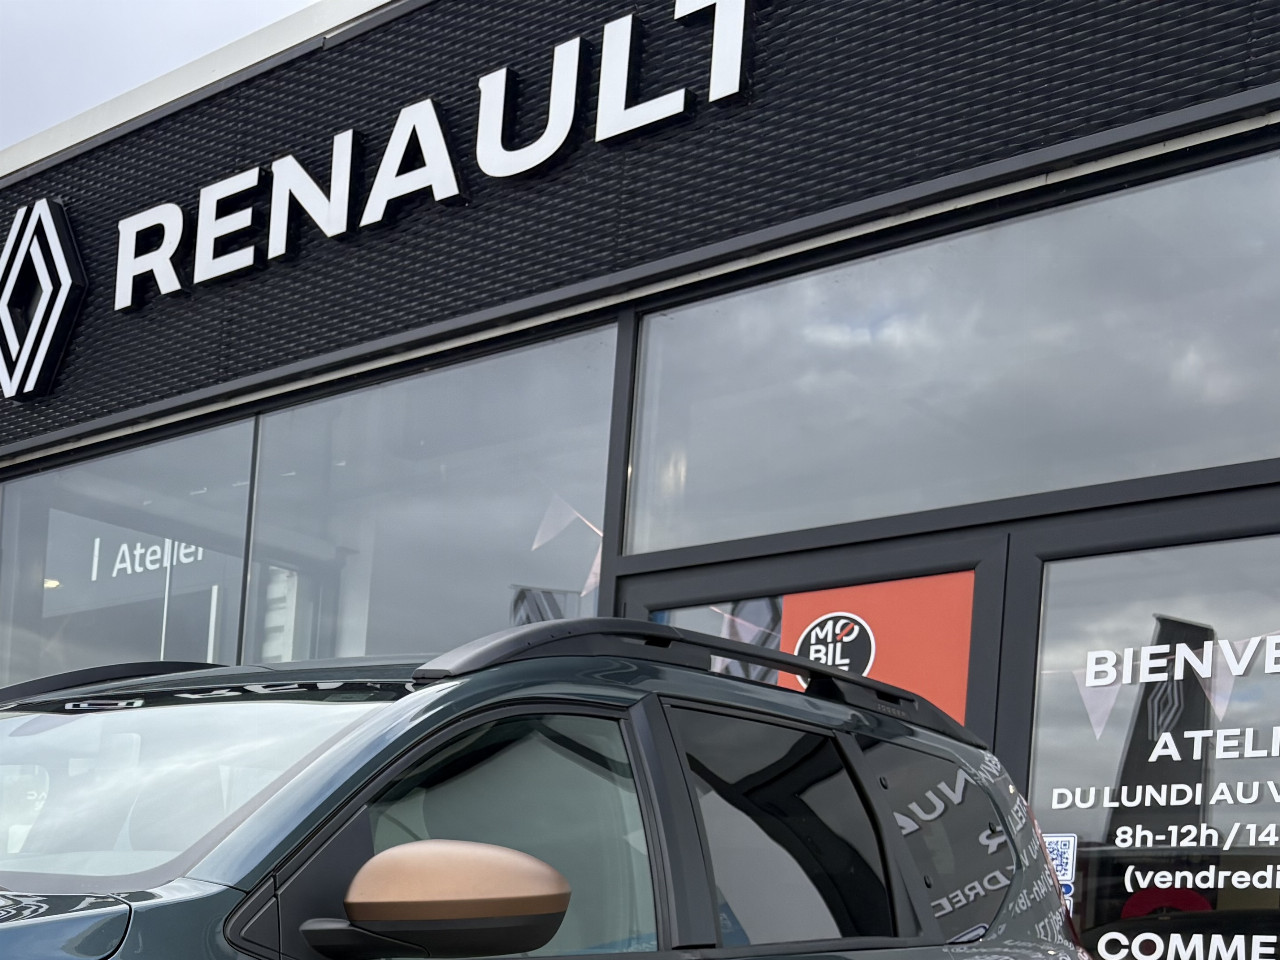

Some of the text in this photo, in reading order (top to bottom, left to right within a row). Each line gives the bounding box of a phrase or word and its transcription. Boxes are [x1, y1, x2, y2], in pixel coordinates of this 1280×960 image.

[115, 0, 747, 310] RENAULT
[809, 642, 850, 666] BIL
[1052, 787, 1096, 809] DU
[1103, 783, 1202, 808] LUNDI
[1209, 781, 1260, 805] AU
[1115, 822, 1219, 848] 8h-12h
